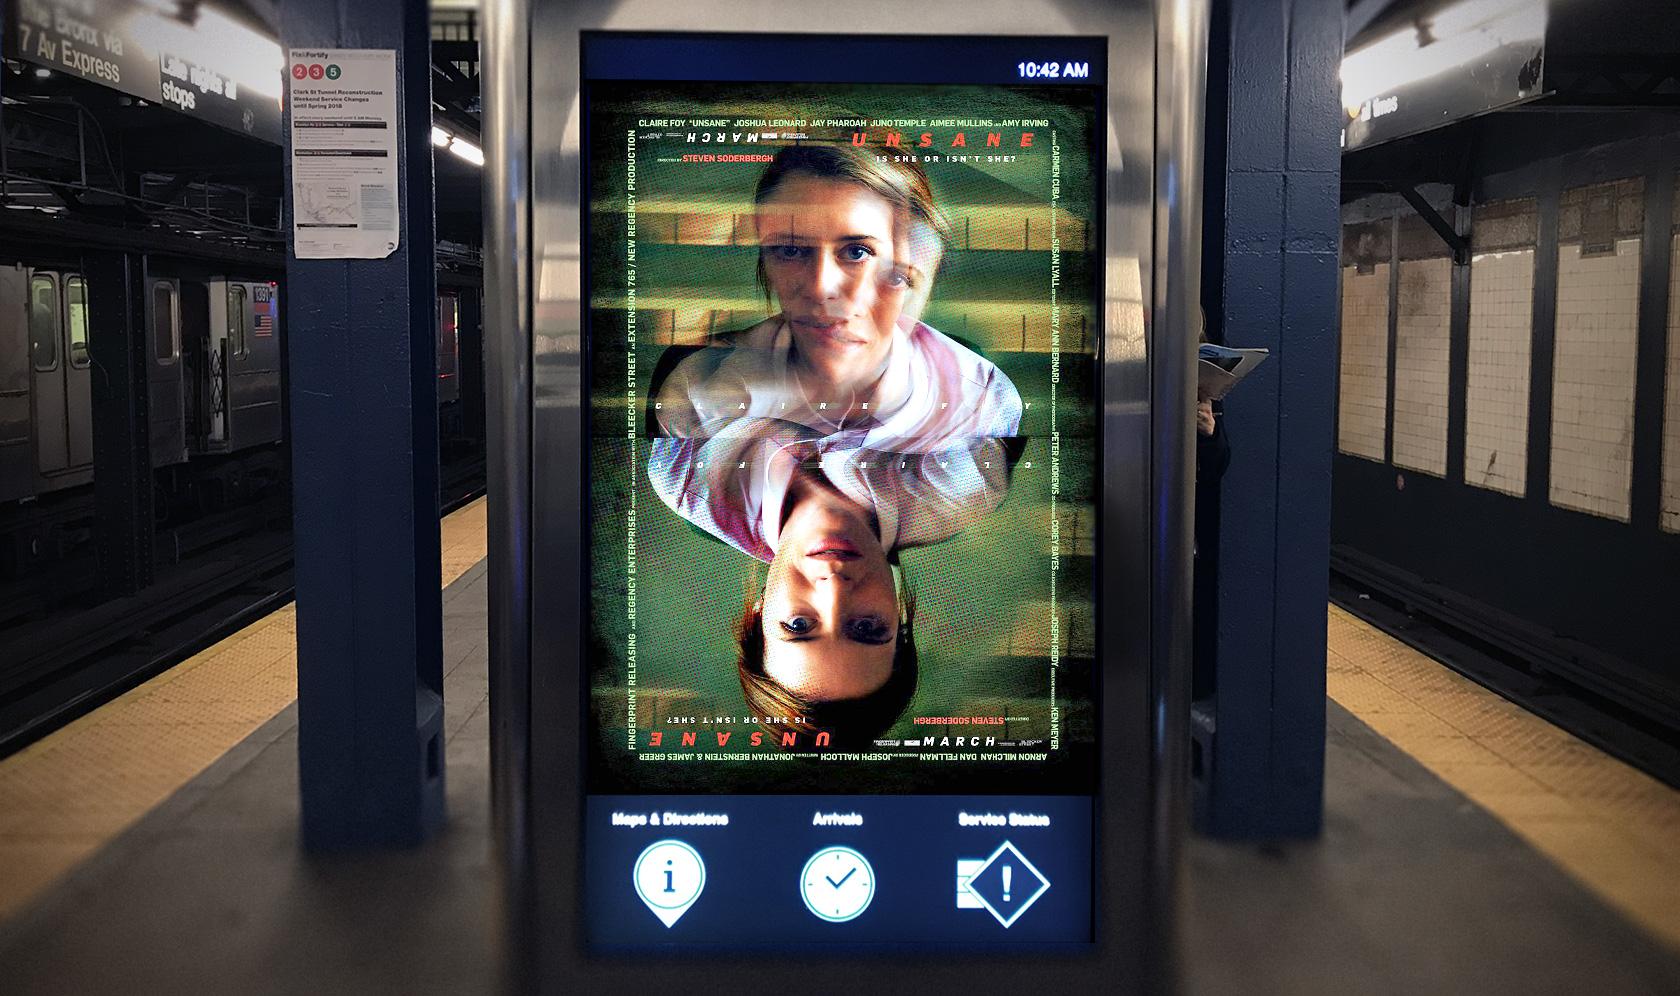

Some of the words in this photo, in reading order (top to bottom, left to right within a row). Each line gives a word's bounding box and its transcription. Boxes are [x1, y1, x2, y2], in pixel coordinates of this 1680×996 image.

[103, 30, 123, 56] via
[19, 24, 30, 51] 7
[37, 31, 56, 60] Av
[61, 39, 120, 83] Express
[1018, 62, 1060, 78] 10:42
[1063, 62, 1089, 78] AM
[162, 80, 196, 111] stops
[344, 96, 369, 104] Changes
[308, 103, 327, 111] Spring
[638, 119, 669, 127] CLAIRE
[669, 119, 686, 127] FOY
[734, 119, 767, 127] JOSHUA
[768, 119, 806, 127] LEONARD
[810, 119, 825, 127] JAY
[827, 119, 867, 127] PHAROAH
[870, 119, 893, 127] JUNO
[894, 119, 927, 127] TEMPLE
[930, 119, 955, 127] AIMEE
[957, 119, 993, 127] MULLINS
[1002, 119, 1021, 127] AMY
[1021, 119, 1049, 127] IRVING
[687, 132, 759, 142] MARCH
[852, 132, 1034, 147] UNSANE
[628, 129, 636, 191] PRODUCTION
[682, 154, 715, 162] STEVEN
[717, 154, 774, 163] SODERBERGH
[876, 155, 888, 163] IS
[894, 155, 917, 163] SHE
[924, 155, 939, 163] OR
[946, 155, 981, 163] ISN'T
[987, 155, 1016, 163] SHE?
[1052, 145, 1060, 177] CARMEN
[1052, 178, 1060, 200] CUBA
[628, 193, 636, 237] REGENCY
[628, 239, 636, 261] NEW
[1052, 238, 1060, 264] SUSAN
[628, 269, 636, 287] 765
[1052, 265, 1060, 288] LYALL
[628, 289, 636, 342] EXTENSION
[1052, 306, 1060, 328] MARY
[1052, 329, 1060, 346] ANN
[628, 351, 636, 388] STREET
[1052, 347, 1060, 383] BERNARD
[942, 402, 1032, 410] FY
[628, 390, 636, 439] BLEECKER
[1052, 431, 1060, 456] PETER
[1052, 457, 1060, 495] ANDREWS
[1052, 519, 1060, 545] COREY
[628, 509, 636, 574] ENTERPRISES
[1052, 545, 1060, 570] BAYES
[628, 576, 636, 620] REGENCY
[1051, 615, 1059, 644] JOSEPH
[628, 633, 636, 686] RELEASING
[1051, 645, 1059, 667] REIDY
[628, 688, 636, 750] FINGERPRINT
[666, 716, 696, 724] SHE?
[702, 716, 736, 724] ISN'T
[743, 716, 758, 724] OR
[765, 716, 788, 724] SHE
[794, 716, 806, 724] IS
[913, 716, 970, 725] SODERBERGH
[971, 716, 1005, 725] STEVEN
[1050, 707, 1059, 723] KEN
[649, 731, 830, 747] UNSANE
[923, 736, 995, 747] MARCH
[1050, 724, 1059, 750] MEYER
[638, 753, 666, 761] GREER
[667, 753, 695, 761] JAMES
[696, 753, 703, 761] &
[704, 753, 751, 761] BERNSTEIN
[752, 753, 796, 761] JONATHAN
[820, 753, 860, 761] MALLOCH
[861, 753, 893, 761] JOSEPH
[919, 753, 958, 761] FELLMAN
[959, 753, 977, 761] DAN
[980, 753, 1017, 761] MILCHAN
[1018, 753, 1048, 761] ARNON
[612, 812, 648, 829] Maps
[650, 812, 660, 826] &
[663, 812, 729, 826] Directions
[813, 812, 864, 826] Arrivals
[958, 812, 1007, 827] Service
[1009, 812, 1051, 827] Status
